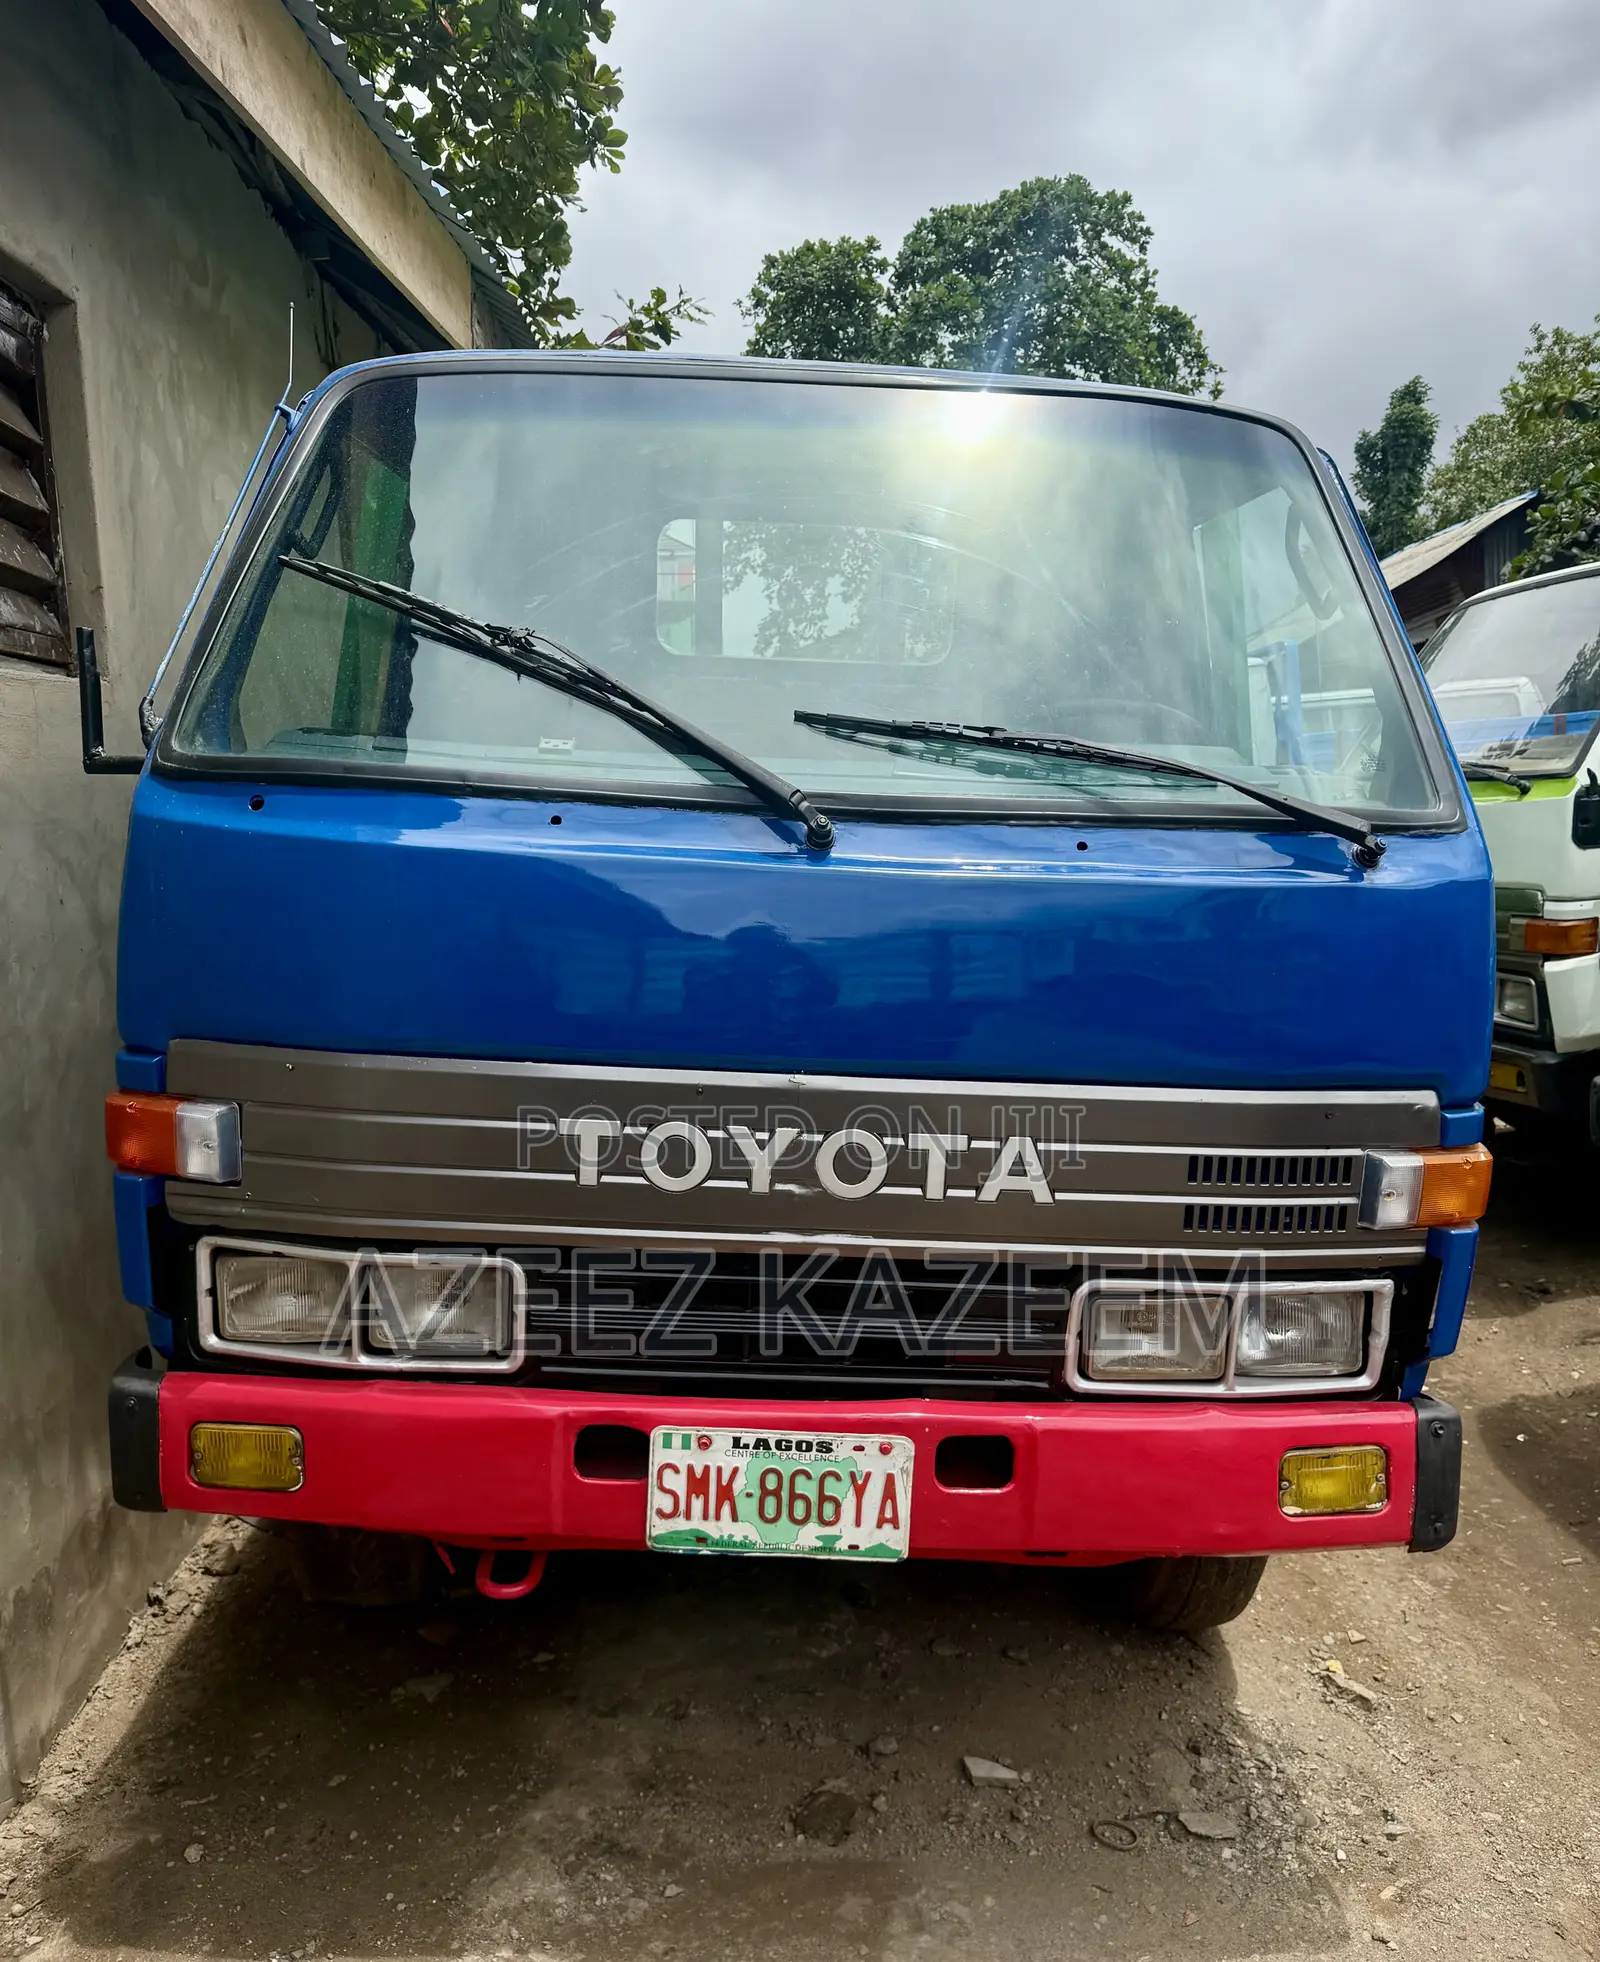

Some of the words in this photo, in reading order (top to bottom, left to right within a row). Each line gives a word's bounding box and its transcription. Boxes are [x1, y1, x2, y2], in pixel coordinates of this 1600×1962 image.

[556, 1117, 1056, 1205] TOYOTA
[731, 1436, 834, 1454] LAGOS
[724, 1448, 760, 1460] CENTRE
[762, 1450, 777, 1461] OF
[779, 1452, 840, 1464] EXCELLENCE
